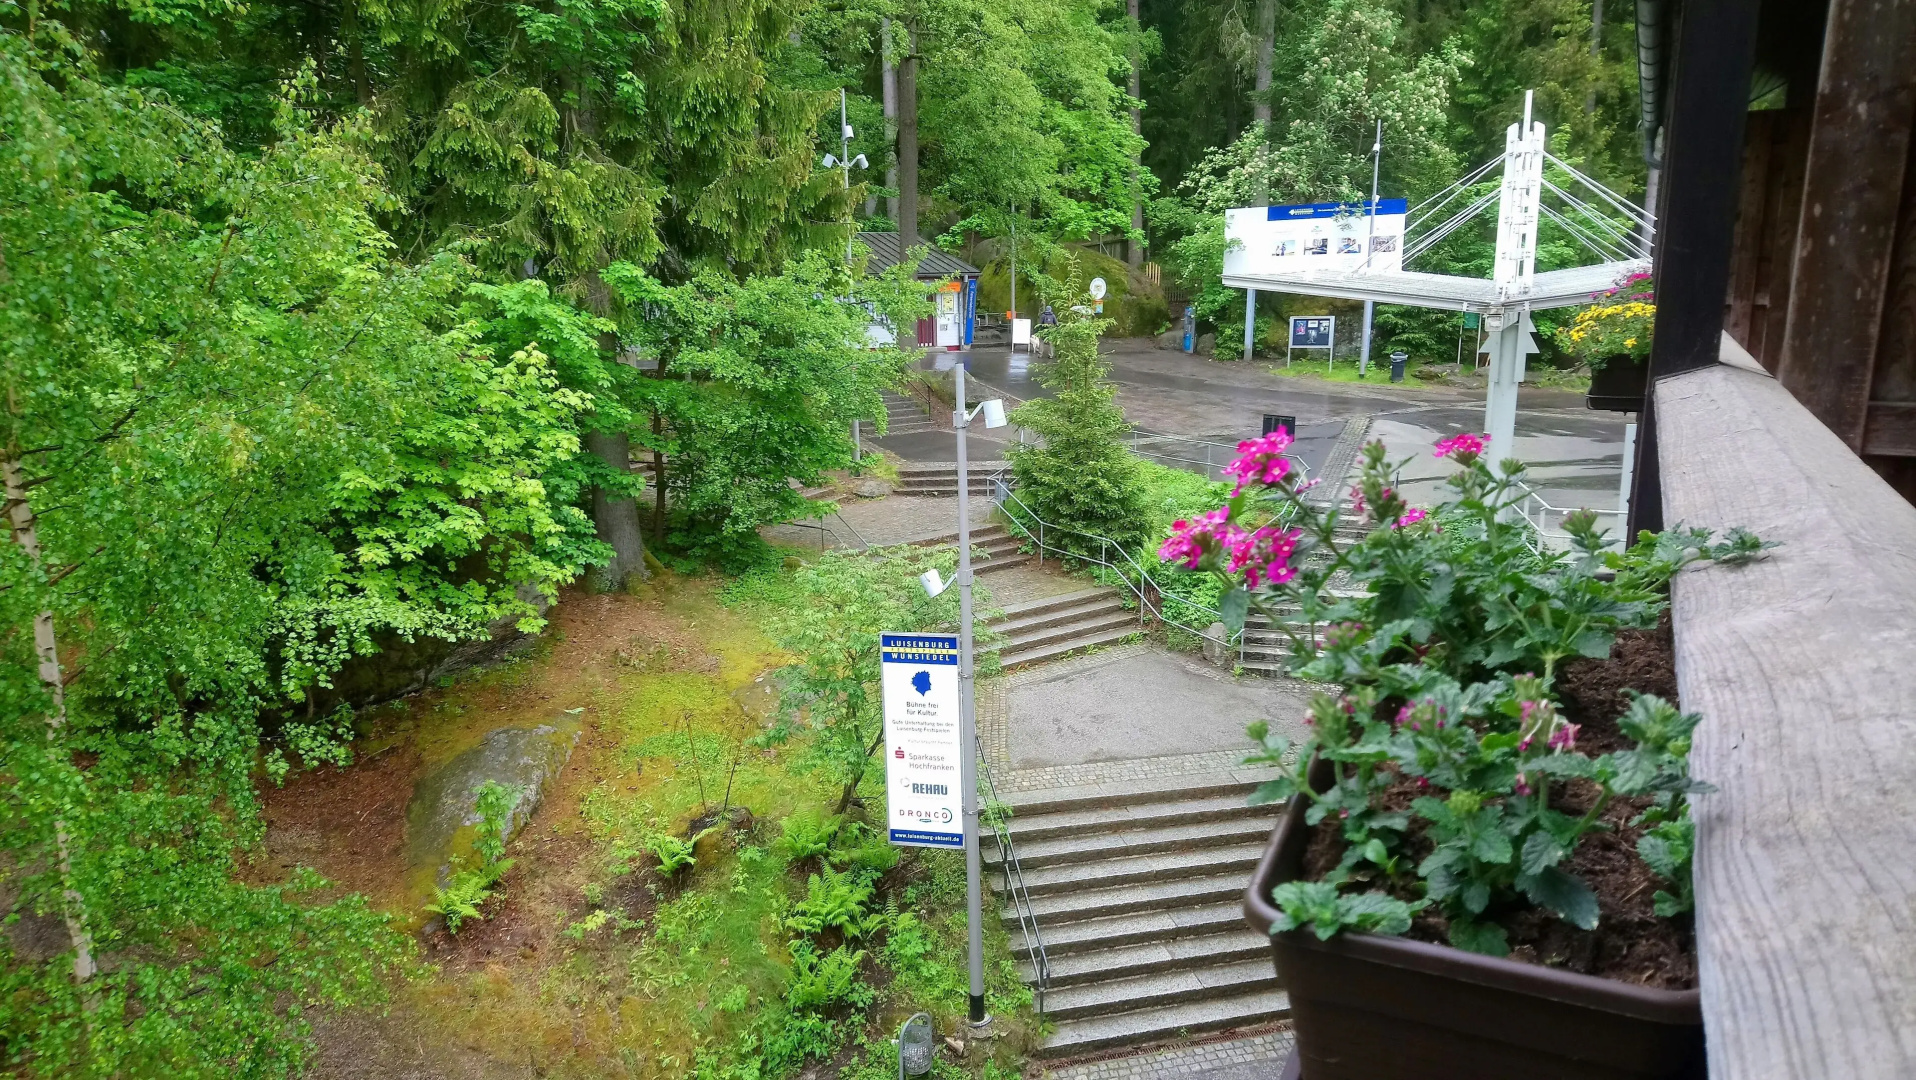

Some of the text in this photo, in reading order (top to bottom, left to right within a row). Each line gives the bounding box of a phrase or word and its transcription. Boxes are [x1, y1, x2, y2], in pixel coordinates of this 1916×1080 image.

[891, 640, 950, 649] LUISENBURG
[891, 653, 950, 661] WUNSIEDEL
[908, 752, 945, 762] Sparkasse
[909, 762, 955, 771] Hochfranken
[912, 783, 948, 795] REHAU
[899, 809, 948, 819] DRONCO
